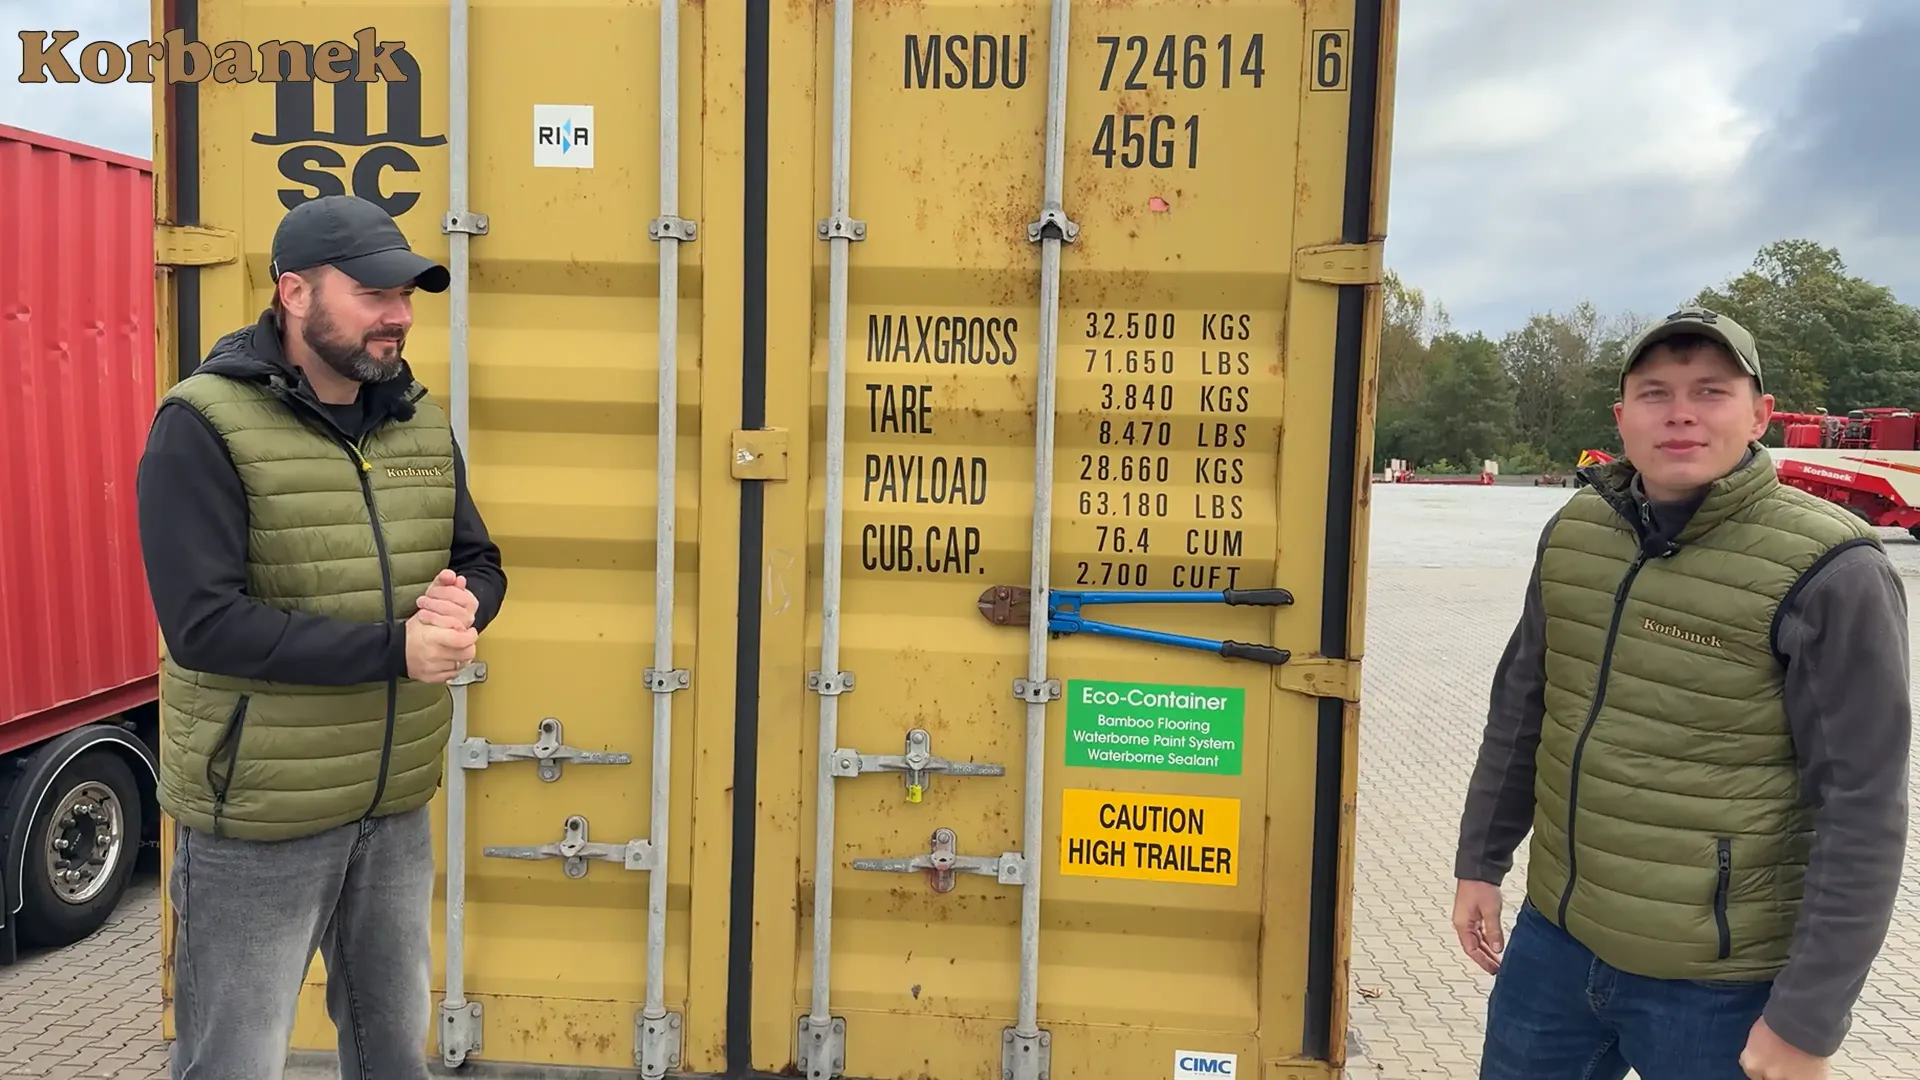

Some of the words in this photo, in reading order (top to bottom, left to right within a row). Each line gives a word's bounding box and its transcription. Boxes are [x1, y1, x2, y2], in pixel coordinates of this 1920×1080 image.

[903, 34, 1028, 90] MSDU
[1097, 33, 1266, 91] 724614
[1316, 32, 1343, 88] 6
[1091, 114, 1200, 169] 45G1
[866, 314, 1018, 366] MAXGROSS
[1202, 313, 1251, 341] KGS
[1201, 350, 1250, 376] LBS
[866, 384, 933, 435] TARE
[1200, 385, 1249, 413] KGS
[1197, 422, 1247, 448] LBS
[386, 467, 443, 478] Korbanek
[863, 454, 987, 506] PAYLOAD
[1195, 457, 1244, 484] KGS
[1803, 465, 1852, 482] Korbanek
[1195, 493, 1243, 519] LBS
[862, 524, 985, 575] CUB.CAP.
[1096, 525, 1149, 553] 76.4
[1186, 529, 1243, 557] CUM
[1172, 564, 1241, 590] CUFT
[1643, 618, 1722, 648] Korbanek
[1082, 687, 1228, 711] Eco-Container
[1098, 714, 1154, 729] Bamboo
[1157, 717, 1211, 734] Flooring
[1073, 730, 1149, 746] Waterborne
[1153, 734, 1186, 748] Paint
[1188, 735, 1236, 751] System
[1087, 748, 1164, 764] Waterborne
[1168, 752, 1219, 767] Sealant
[1099, 803, 1204, 835] CAUTION
[1068, 838, 1126, 867] HIGH
[1133, 842, 1232, 874] TRAILER
[1179, 1056, 1232, 1075] CIMC
